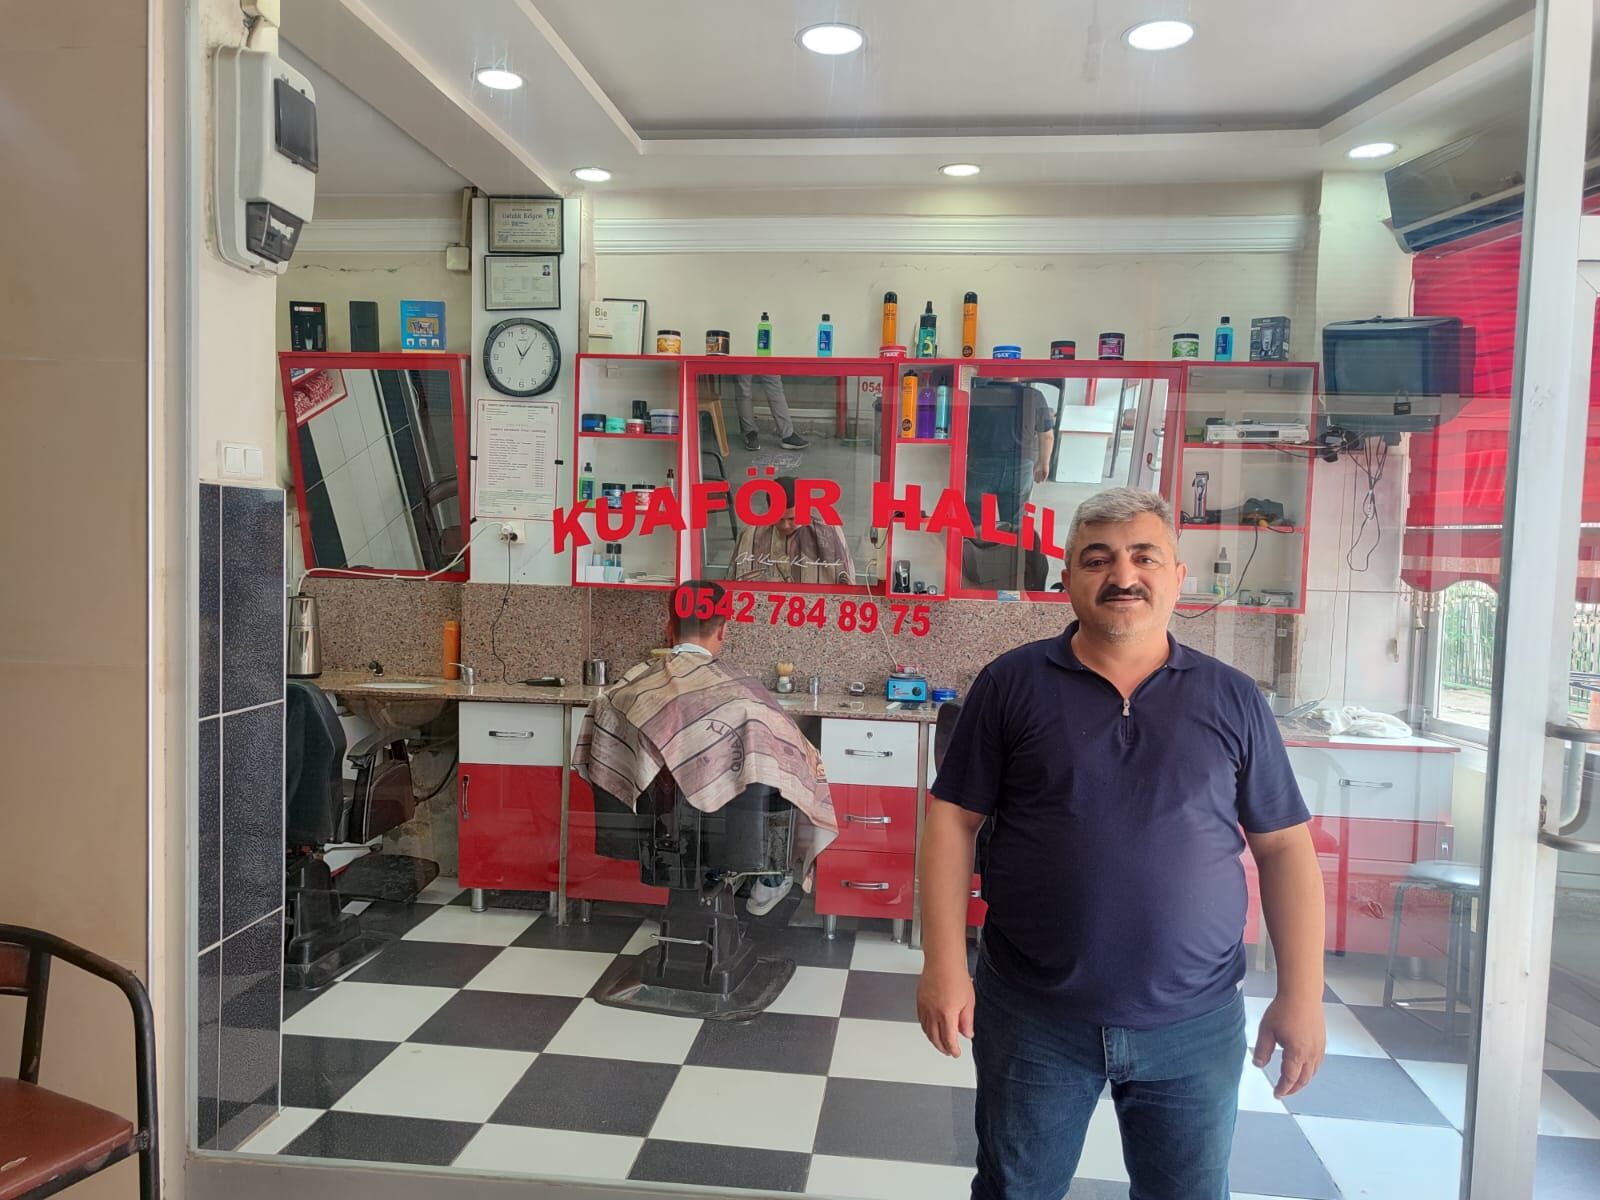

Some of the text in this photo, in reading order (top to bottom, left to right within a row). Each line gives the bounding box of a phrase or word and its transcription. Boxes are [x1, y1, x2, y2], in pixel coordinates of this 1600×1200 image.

[553, 466, 843, 555] KUAFÖR
[674, 586, 932, 638] 0542 784 89 75
